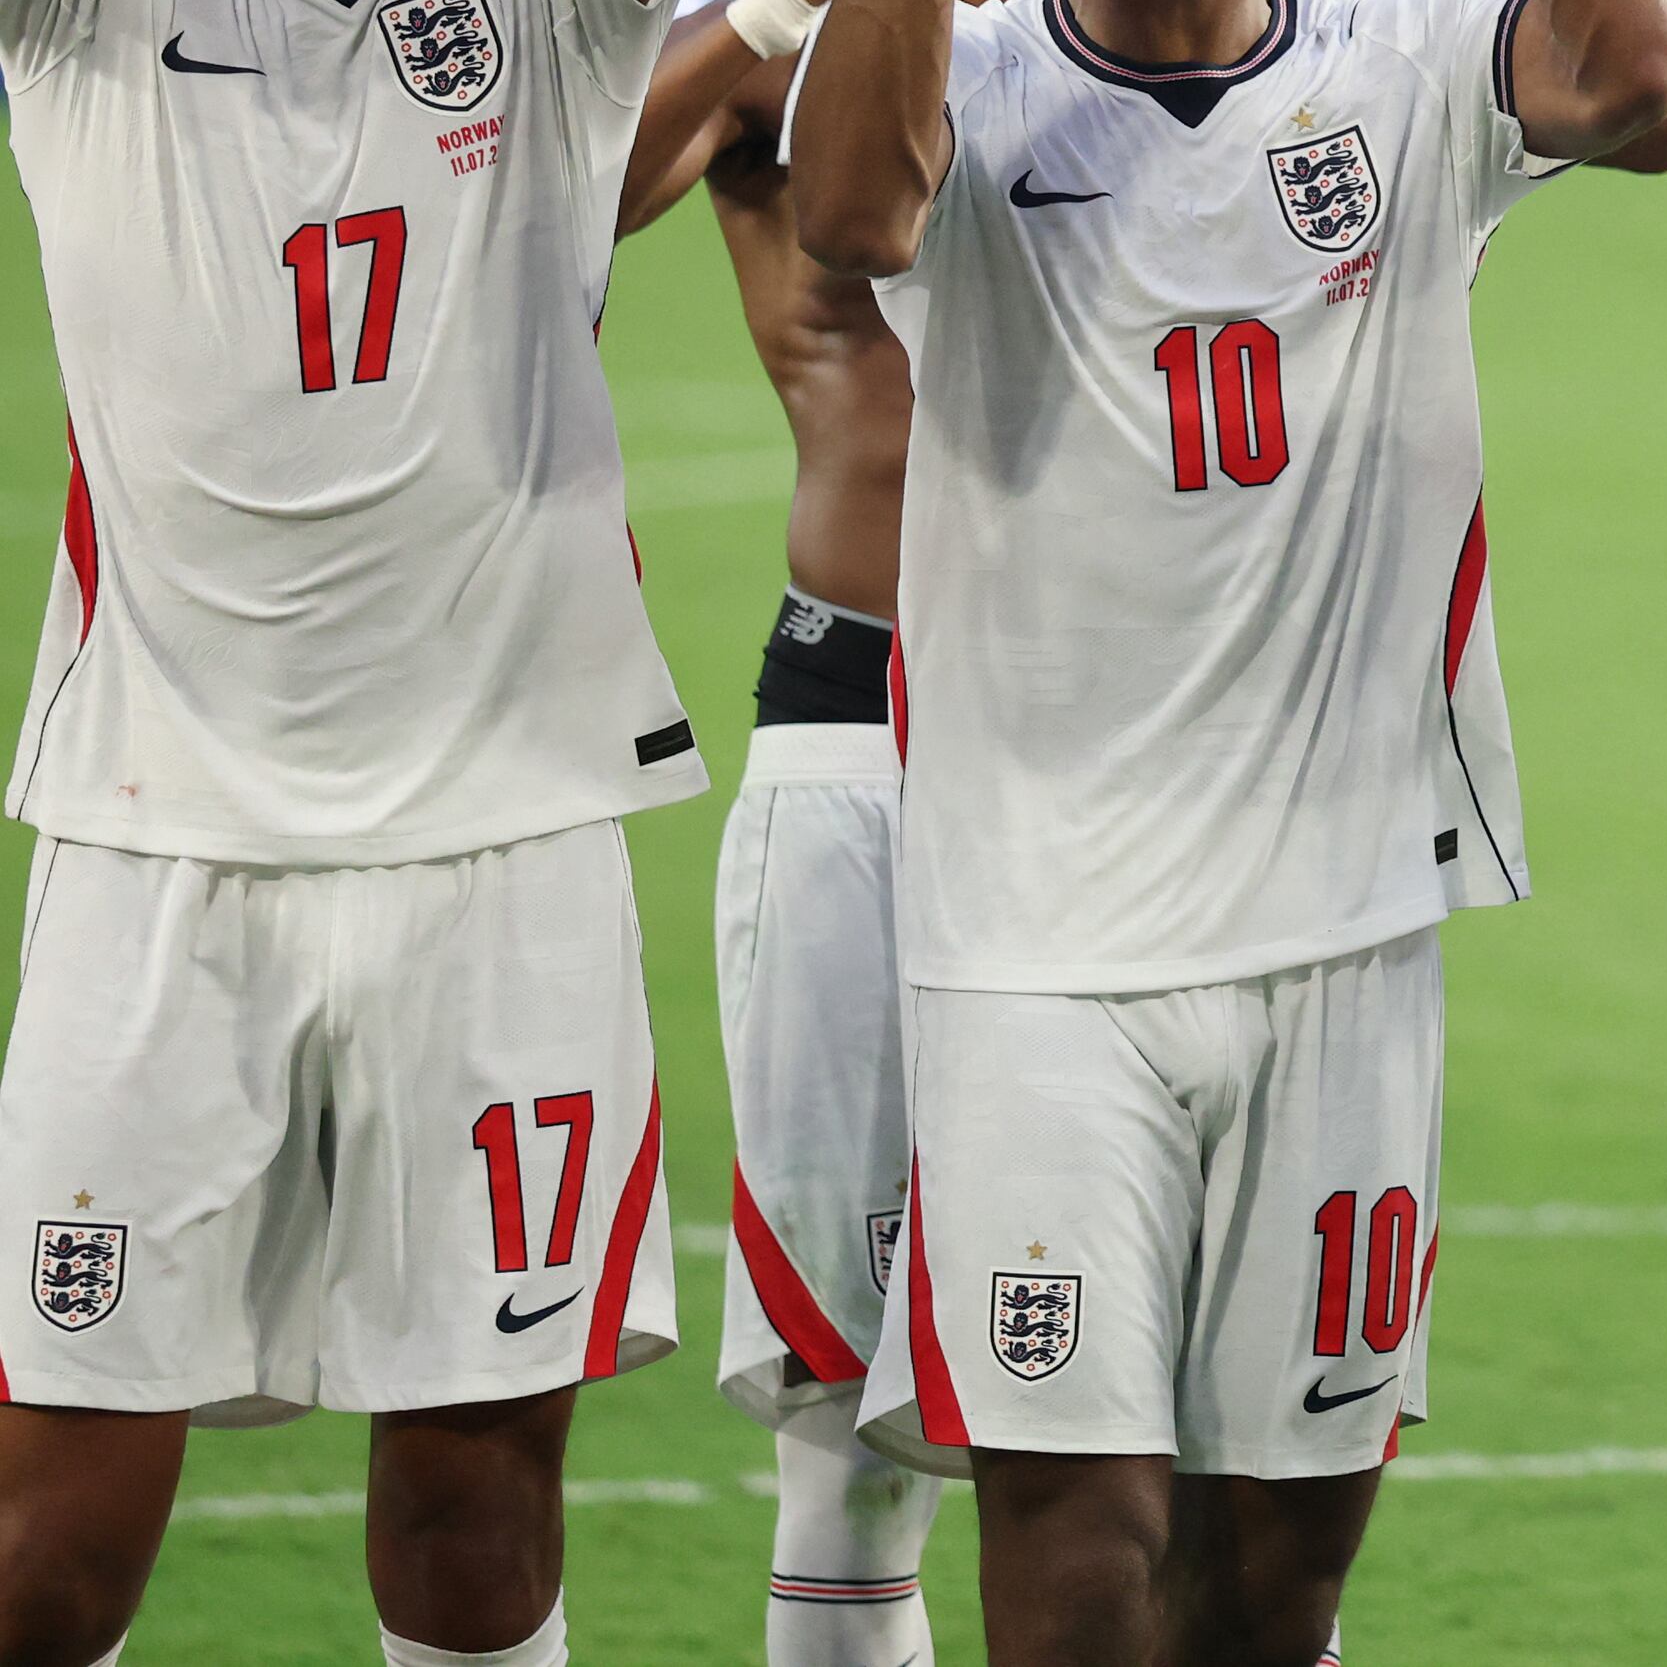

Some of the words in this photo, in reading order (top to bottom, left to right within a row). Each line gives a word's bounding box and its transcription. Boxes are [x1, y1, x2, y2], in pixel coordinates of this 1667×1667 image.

[436, 114, 505, 154] NORWAY
[450, 144, 498, 177] 11.07.2
[283, 206, 407, 394] 17
[1326, 277, 1370, 307] 11.07.2
[1153, 318, 1290, 492] 10
[472, 1091, 594, 1273] 17
[1313, 1187, 1419, 1357] 10
